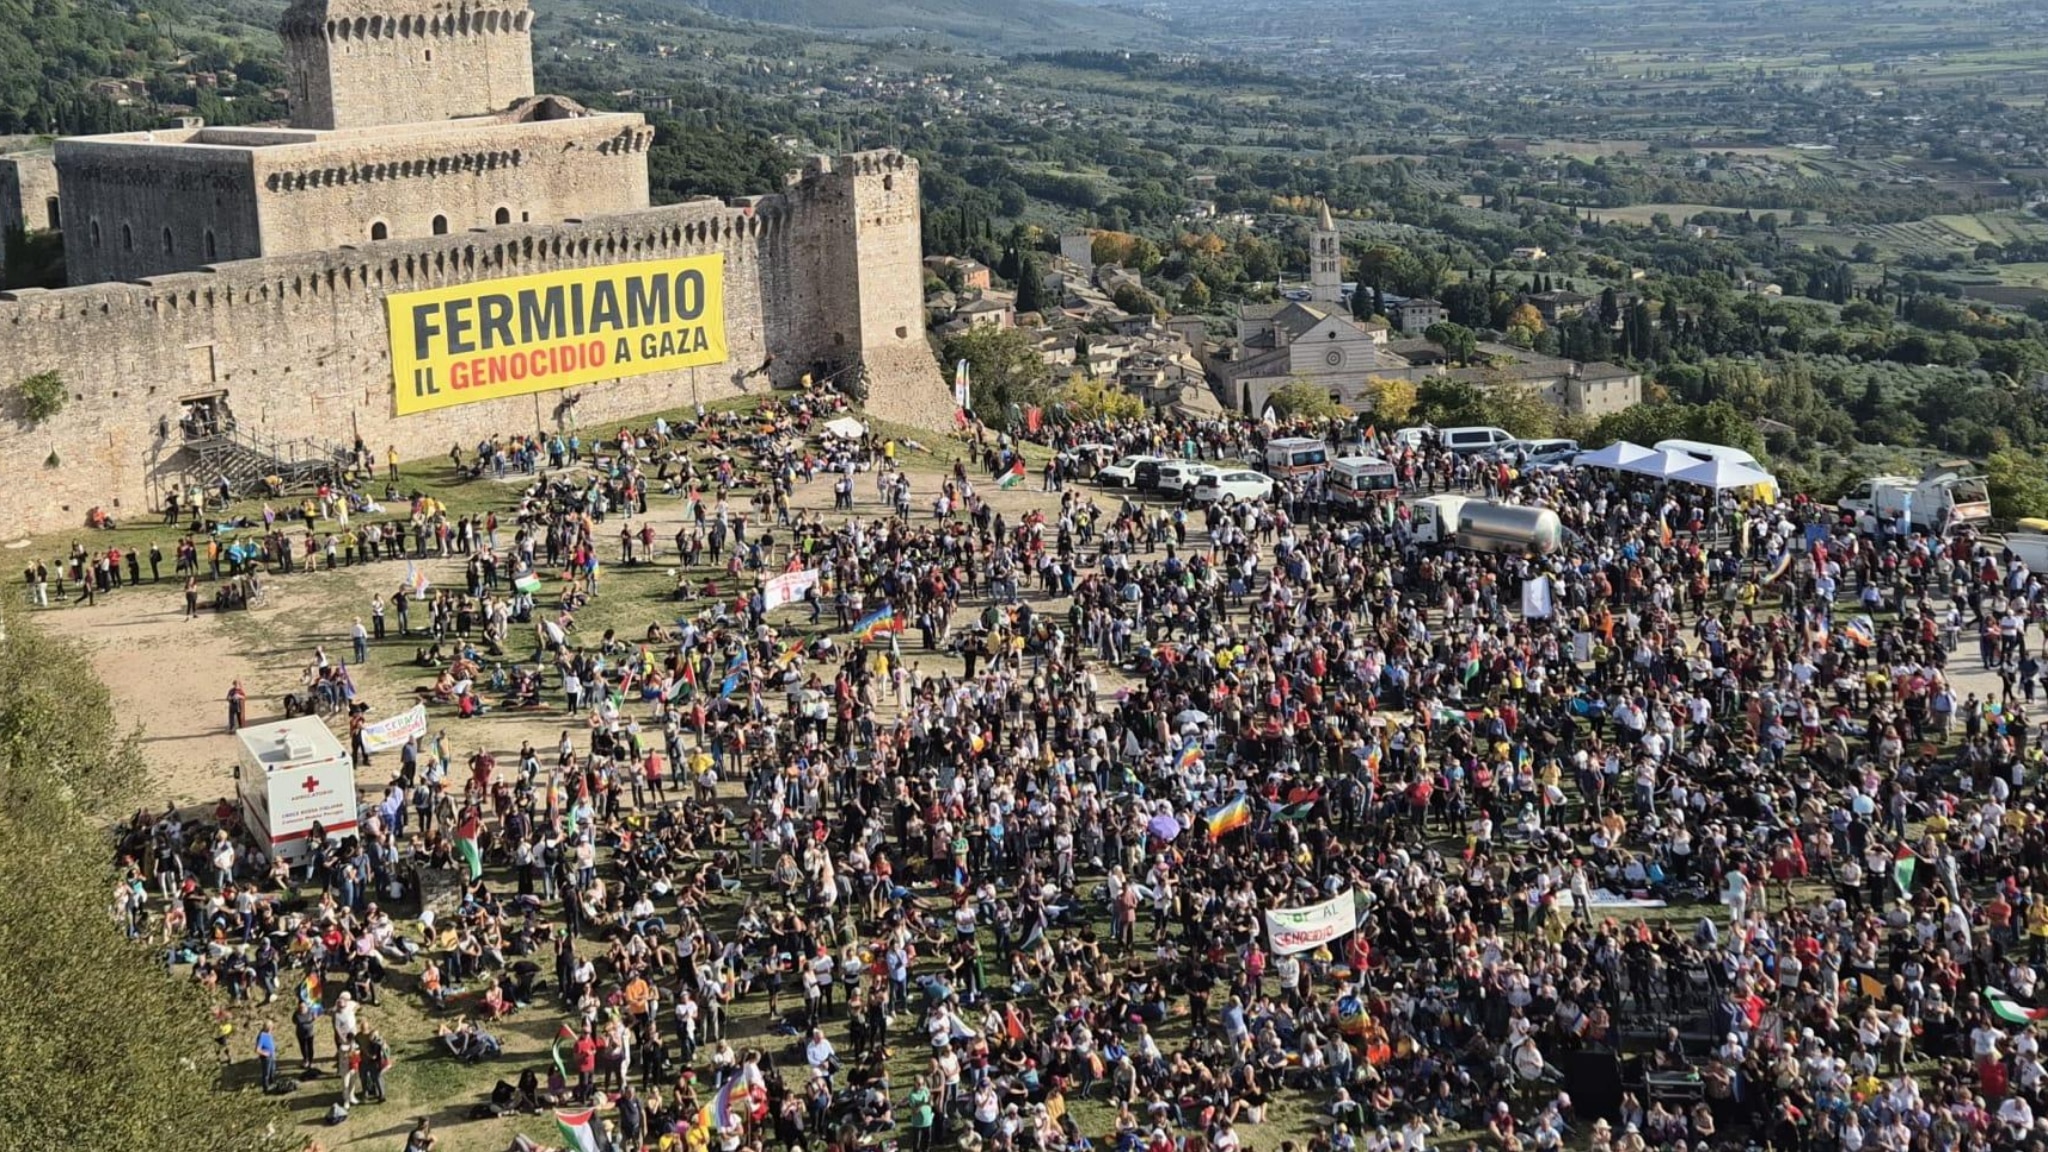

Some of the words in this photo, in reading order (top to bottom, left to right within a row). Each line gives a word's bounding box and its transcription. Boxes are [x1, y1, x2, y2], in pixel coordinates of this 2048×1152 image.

[412, 268, 705, 360] FERMIAMO
[414, 368, 441, 397] IL
[450, 339, 606, 390] GENOCIDIO
[613, 337, 632, 364] A
[640, 326, 709, 359] GAZA
[1323, 903, 1339, 919] AL
[1274, 925, 1334, 947] GENOCIDIO
